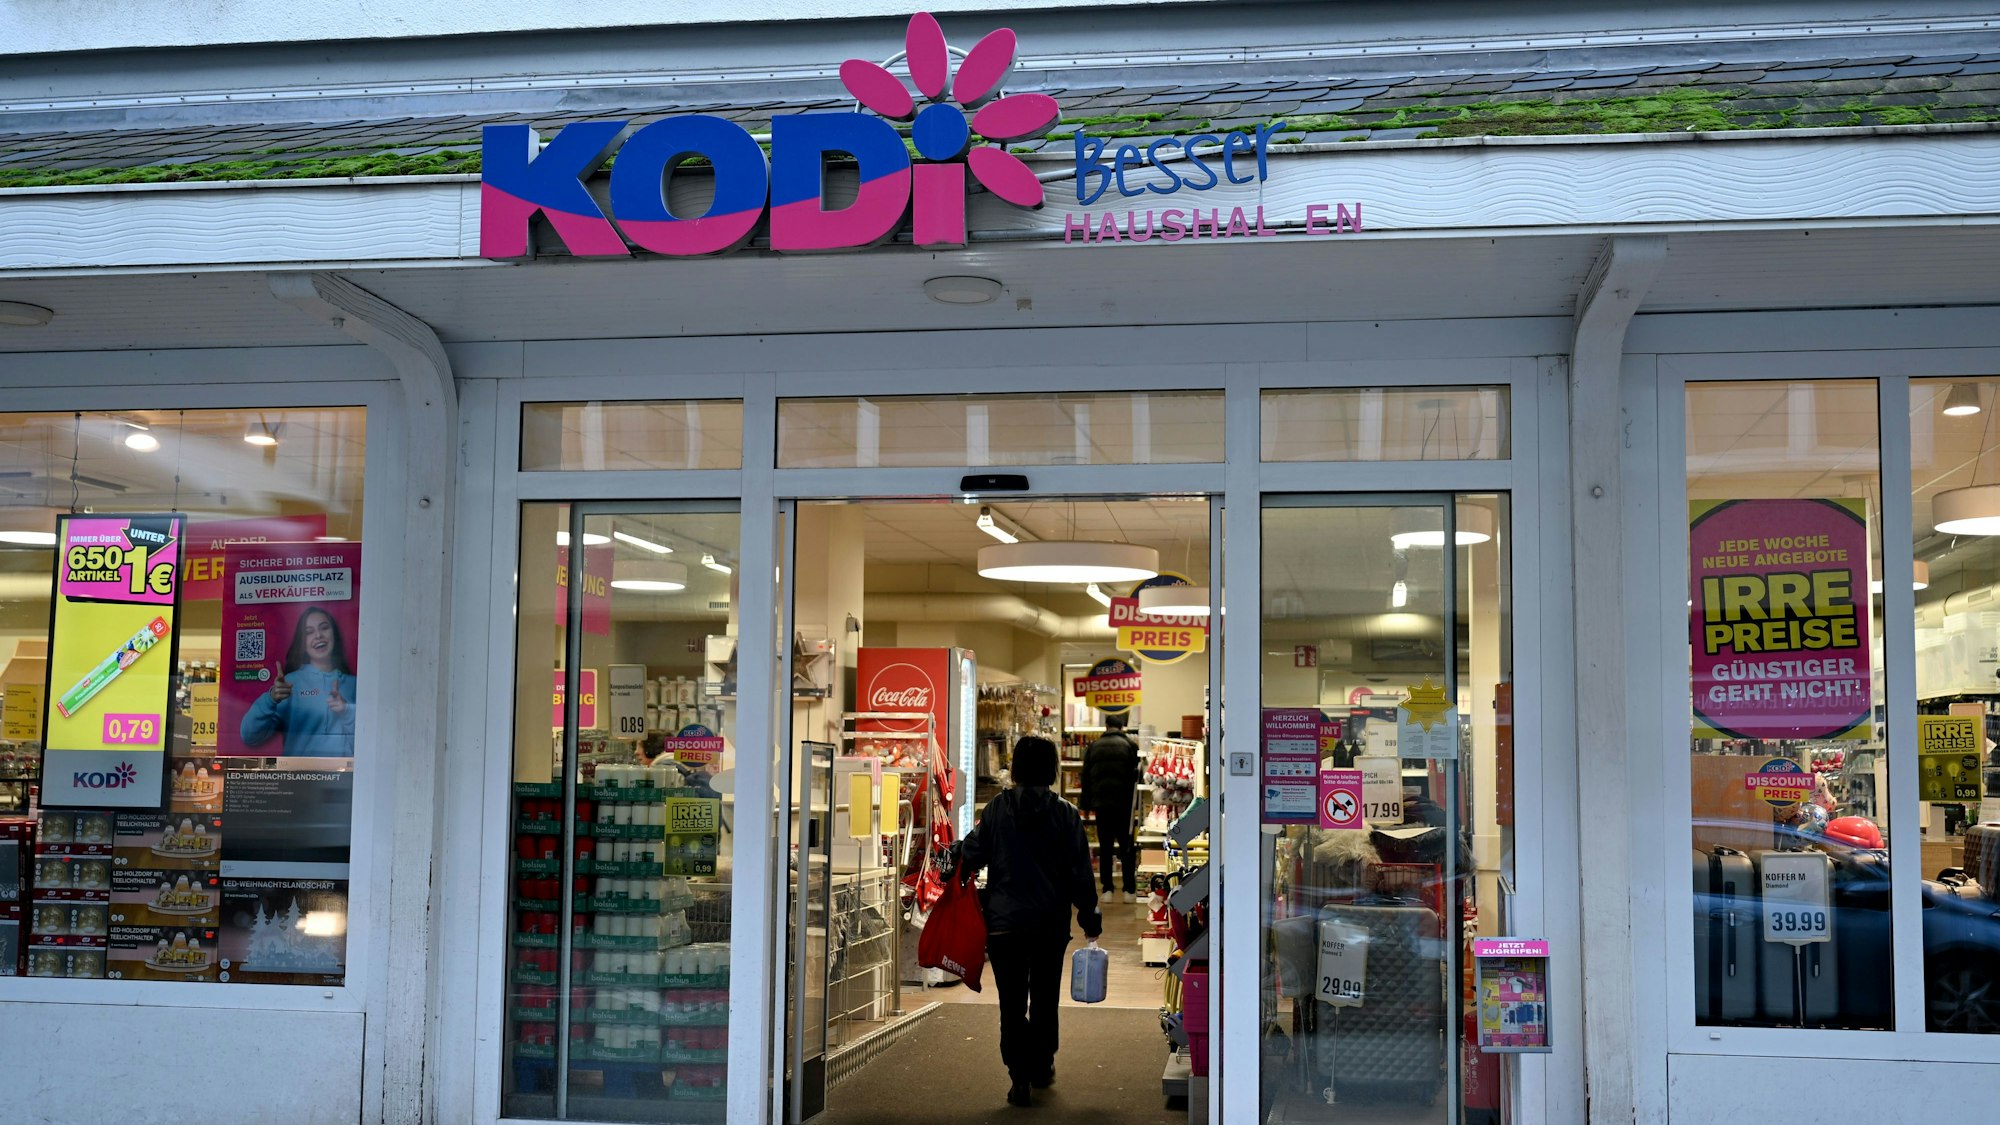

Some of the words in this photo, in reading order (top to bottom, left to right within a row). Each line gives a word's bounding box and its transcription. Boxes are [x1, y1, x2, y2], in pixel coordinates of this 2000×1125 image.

[70, 535, 98, 543] IMMER
[99, 534, 122, 543] ÜBER
[130, 528, 166, 543] UNTER
[1718, 538, 1759, 553] JEDE
[1764, 535, 1830, 551] WOCHE
[67, 545, 123, 570] 650
[239, 559, 283, 569] SICHERE
[285, 557, 303, 566] DIR
[306, 555, 344, 565] DEINEN
[1702, 555, 1750, 569] NEUE
[1754, 549, 1848, 566] ANGEBOTE
[67, 570, 121, 581] ARTIKEL
[239, 572, 344, 585] AUSBILDUNGSPLATZ
[239, 592, 253, 600] ALS
[255, 586, 325, 599] VERKÄUFER
[1702, 569, 1857, 624] IRRE
[1130, 631, 1191, 647] PREIS
[1704, 617, 1859, 654] PREISE
[1711, 657, 1856, 681] GÜNSTIGER
[1708, 683, 1773, 703] GEHT
[1780, 679, 1862, 700] NICHT!
[872, 686, 931, 707] Coca-Cola
[1094, 693, 1135, 704] PREIS
[193, 721, 220, 735] 29.9
[621, 716, 644, 733] 0.89
[108, 719, 154, 743] 0,79
[1924, 723, 1974, 739] IRRE
[667, 740, 722, 749] DISCOUNT
[1925, 738, 1976, 749] PREISE
[680, 751, 712, 760] PREIS
[226, 772, 340, 781] LED-WEIHNACHTSLANDSCHAFT
[1747, 776, 1813, 786] DISCOUNT
[515, 783, 540, 793] bolsius
[594, 789, 618, 797] bolsius
[1763, 789, 1801, 799] PREIS
[1956, 789, 1976, 798] 0,99
[672, 805, 712, 819] IRRE
[1363, 802, 1400, 818] 17.99
[521, 823, 547, 831] bolsius
[672, 818, 714, 828] PREISE
[595, 825, 620, 834] bolsius
[595, 863, 620, 871] bolsius
[695, 865, 712, 873] 0,99
[112, 870, 154, 878] LED-HOLZDORF
[1765, 873, 1796, 881] KOFFER
[112, 877, 156, 885] TEELICHTHALTER
[223, 880, 336, 890] LED-WEIHNACHTSLANDSCHAFT
[519, 900, 543, 909] bolsius
[593, 899, 618, 908] bolsius
[1771, 912, 1826, 931] 39.99
[518, 935, 544, 944] bolsius
[591, 936, 616, 945] bolsius
[1322, 940, 1345, 950] KOFFER
[941, 955, 967, 978] REWE
[591, 973, 616, 983] bolsius
[664, 975, 690, 984] bolsius
[1322, 976, 1361, 999] 29.99
